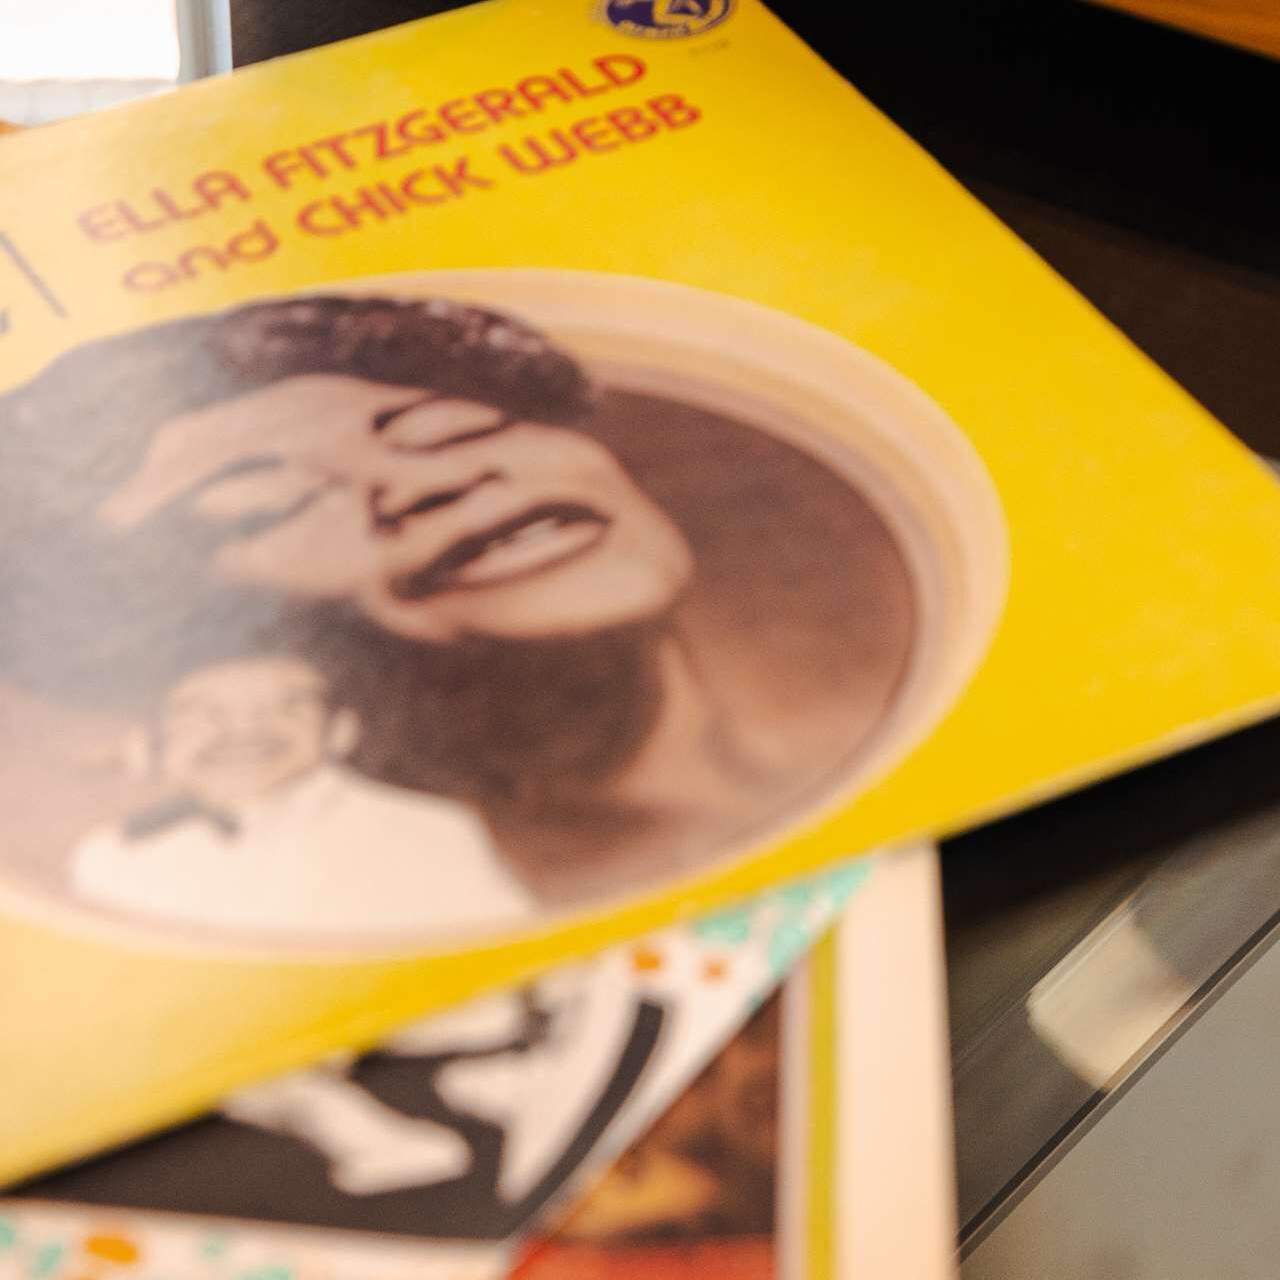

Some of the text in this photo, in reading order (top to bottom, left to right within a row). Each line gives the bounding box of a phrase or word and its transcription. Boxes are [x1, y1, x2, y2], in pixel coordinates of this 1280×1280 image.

[77, 53, 647, 245] ELLA FITZGERALD
[121, 93, 702, 299] and CHICK WEBB
